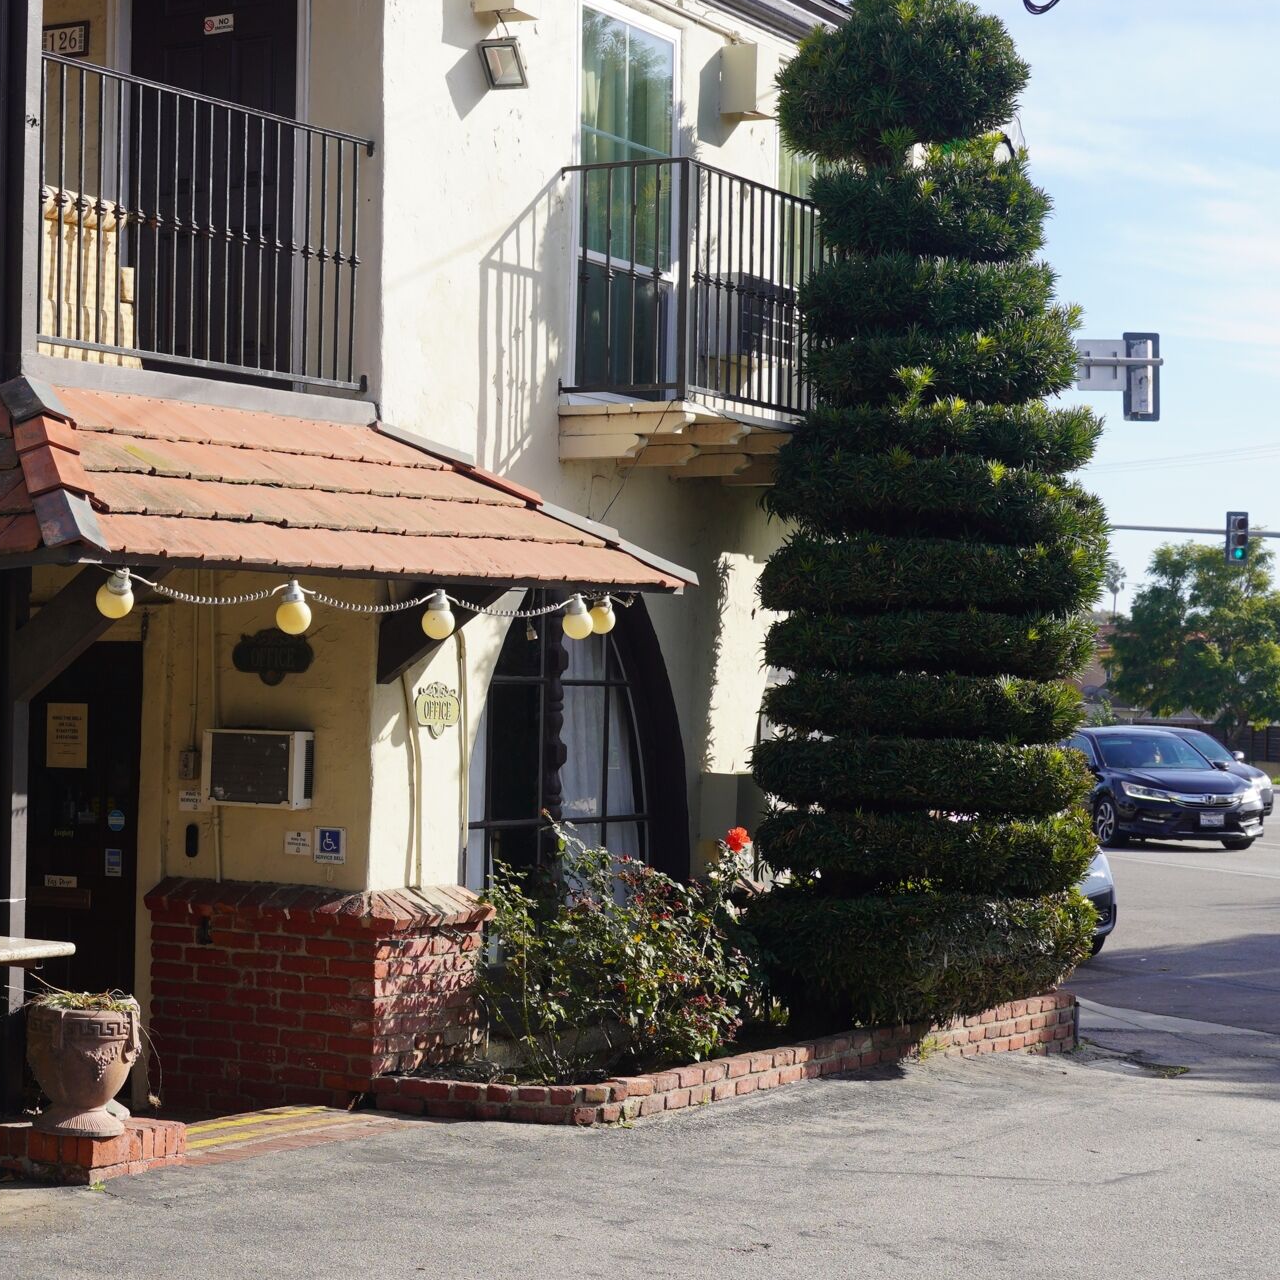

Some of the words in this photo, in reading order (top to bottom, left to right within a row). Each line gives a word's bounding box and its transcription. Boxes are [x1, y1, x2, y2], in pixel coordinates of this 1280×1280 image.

[50, 29, 77, 52] 126
[250, 647, 295, 668] OFFICE
[423, 700, 451, 720] OFFICE
